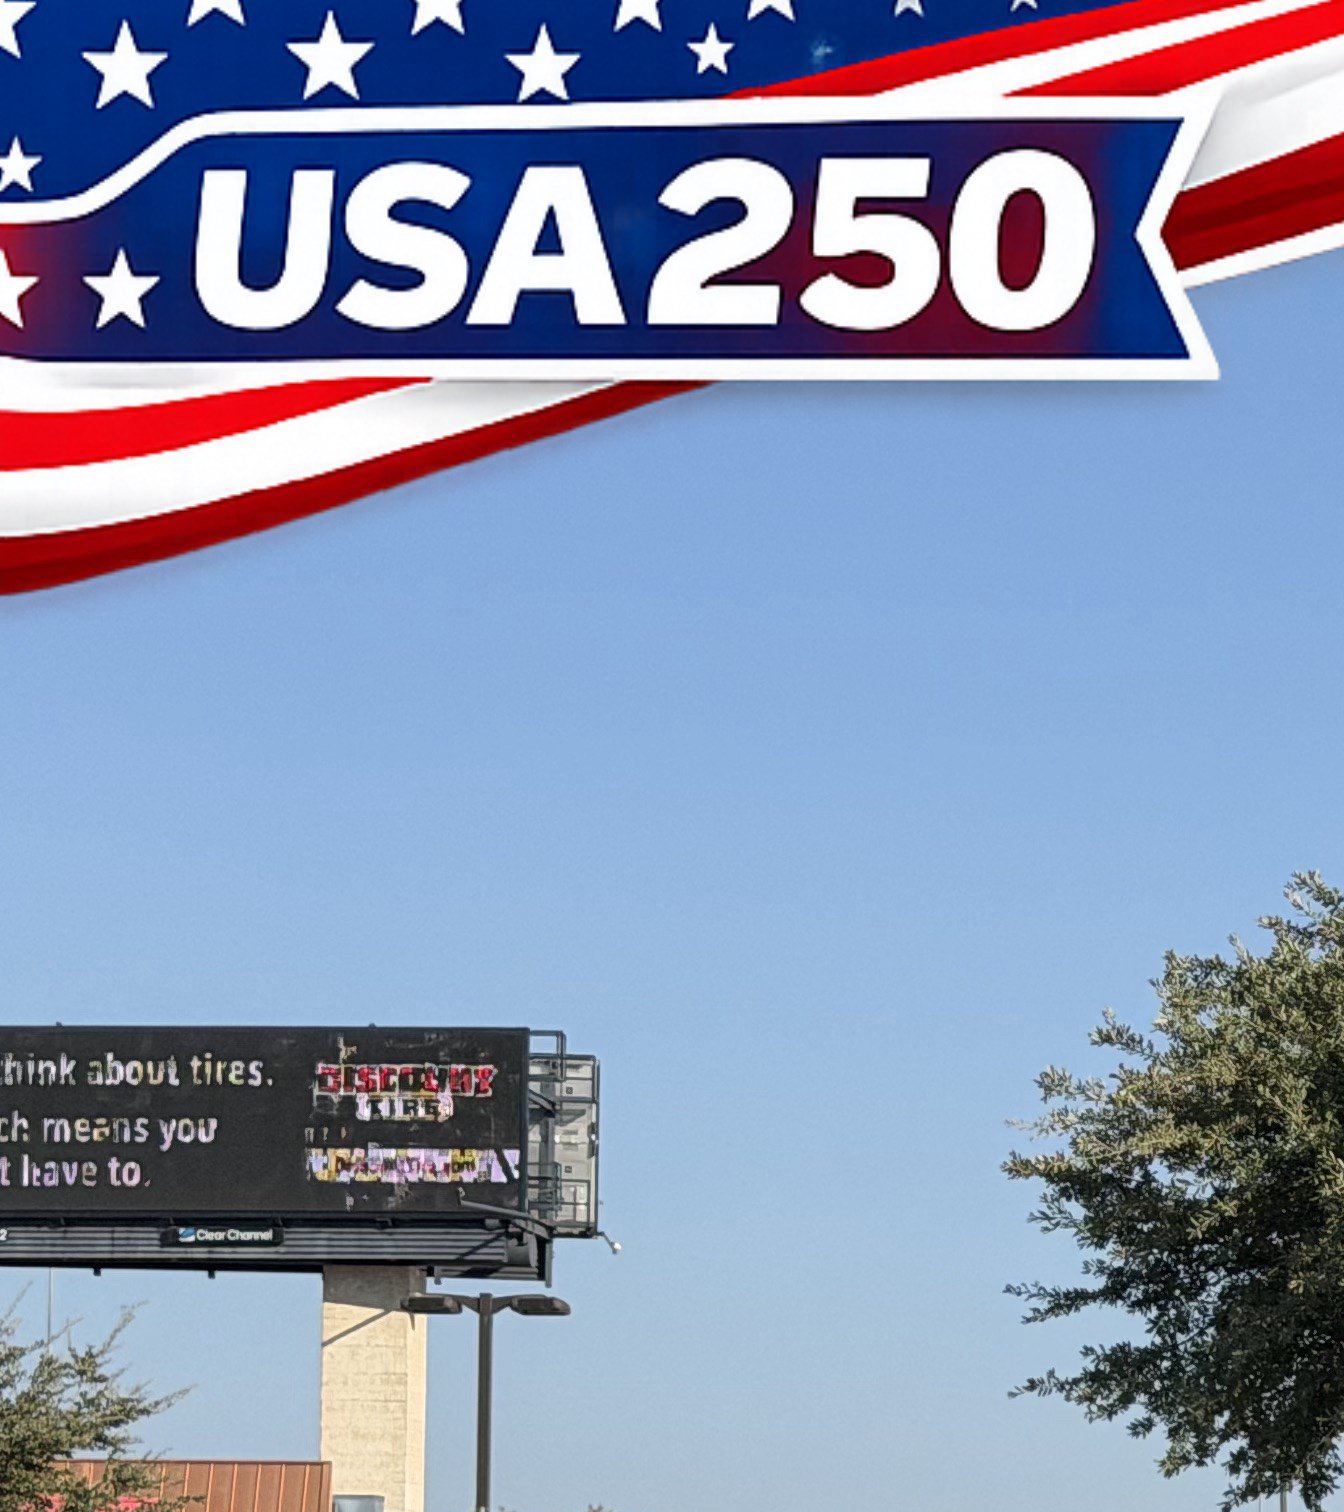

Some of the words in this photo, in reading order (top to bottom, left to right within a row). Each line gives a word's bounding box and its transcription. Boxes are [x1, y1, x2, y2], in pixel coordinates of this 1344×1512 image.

[0, 1052, 76, 1086] hink
[87, 1052, 180, 1087] about
[190, 1052, 274, 1087] tires.
[43, 1117, 150, 1144] means
[159, 1117, 218, 1152] you
[21, 1153, 98, 1188] have
[196, 1228, 227, 1241] Clear
[227, 1228, 273, 1241] Channel
